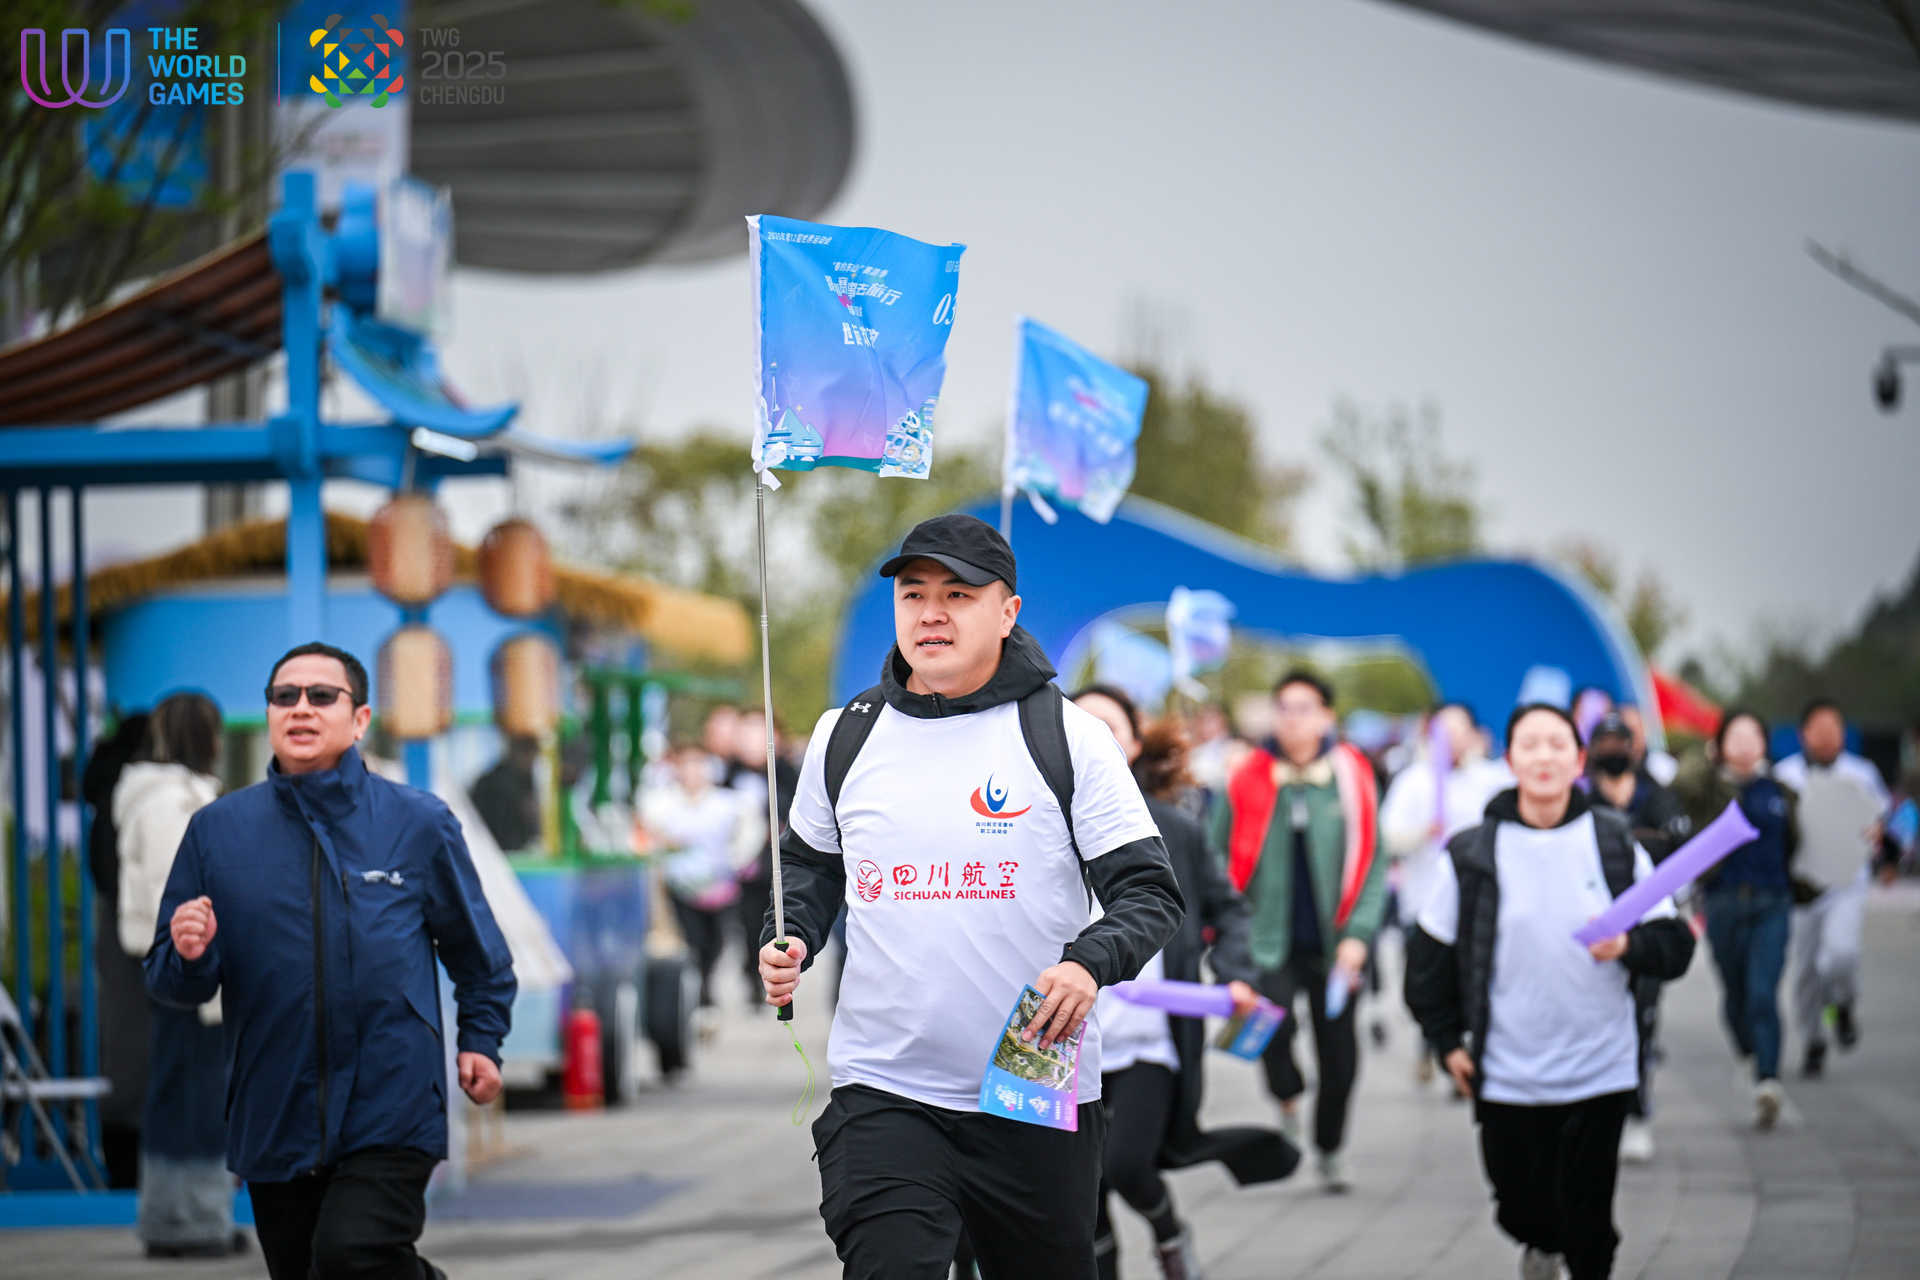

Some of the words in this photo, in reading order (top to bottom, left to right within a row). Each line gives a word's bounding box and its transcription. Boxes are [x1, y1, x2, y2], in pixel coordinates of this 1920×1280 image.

[892, 860, 1019, 888] 四川航空
[893, 889, 951, 900] SICHUAN
[955, 889, 1016, 900] AIRLINES
